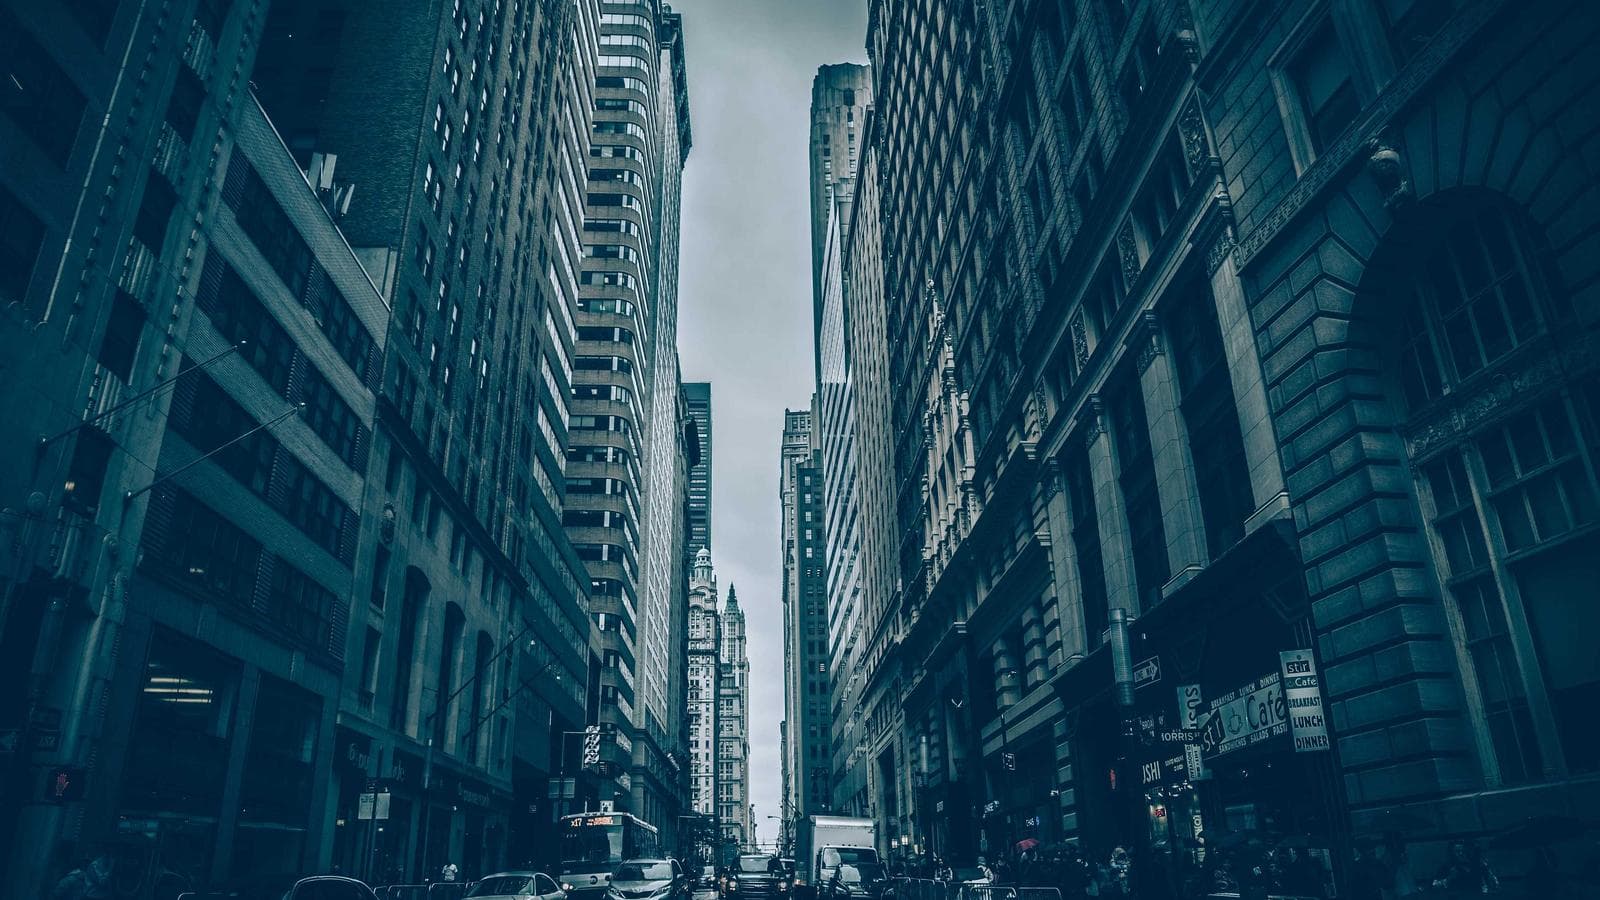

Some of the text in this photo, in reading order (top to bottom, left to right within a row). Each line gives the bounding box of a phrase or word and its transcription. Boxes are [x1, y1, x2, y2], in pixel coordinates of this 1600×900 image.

[1288, 661, 1308, 673] stir
[1210, 672, 1281, 709] BREAKFAST LUNCH DINNER
[1288, 697, 1321, 709] BREAKFAST
[1247, 690, 1287, 731] Café
[1293, 716, 1324, 728] LUNCH
[1250, 728, 1269, 744] SALADS
[1296, 735, 1329, 749] DINNER
